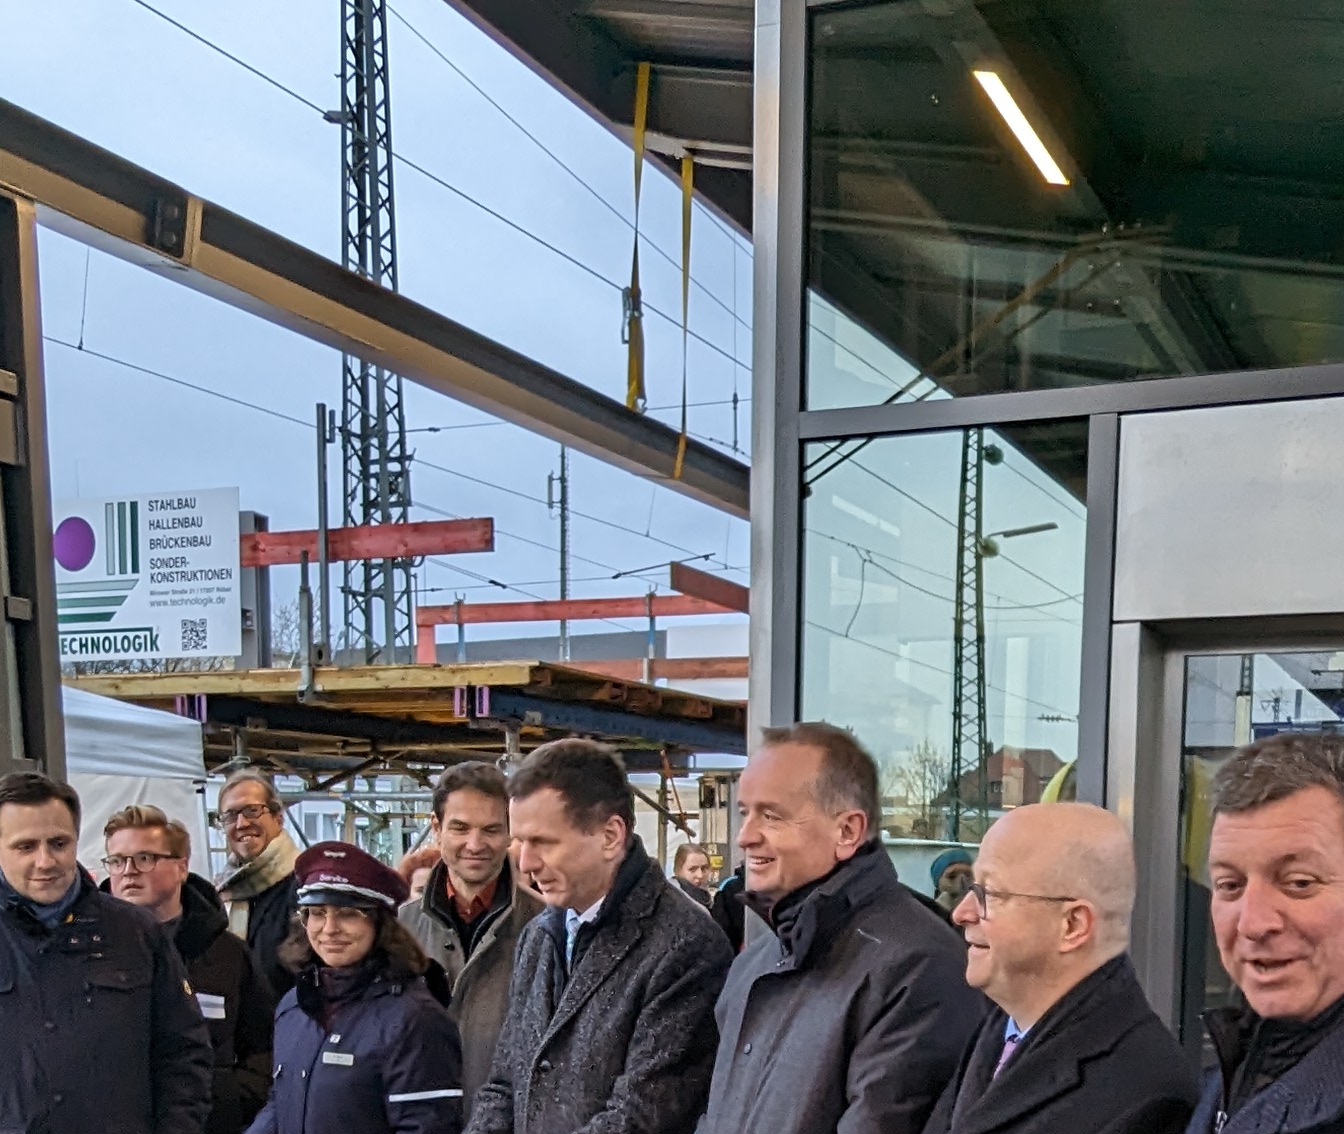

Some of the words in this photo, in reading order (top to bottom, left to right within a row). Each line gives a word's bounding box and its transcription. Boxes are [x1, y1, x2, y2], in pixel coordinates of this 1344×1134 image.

[148, 497, 197, 512] STAHLBAU
[149, 516, 203, 531] HALLENBAU
[149, 535, 212, 550] BRÜCKENBAU
[149, 556, 190, 570] SONDER-
[150, 568, 233, 584] KONSTRUKTIONEN
[149, 595, 226, 607] www.technologik.de
[60, 633, 160, 655] ECHNOLOGIK
[319, 874, 349, 883] Service
